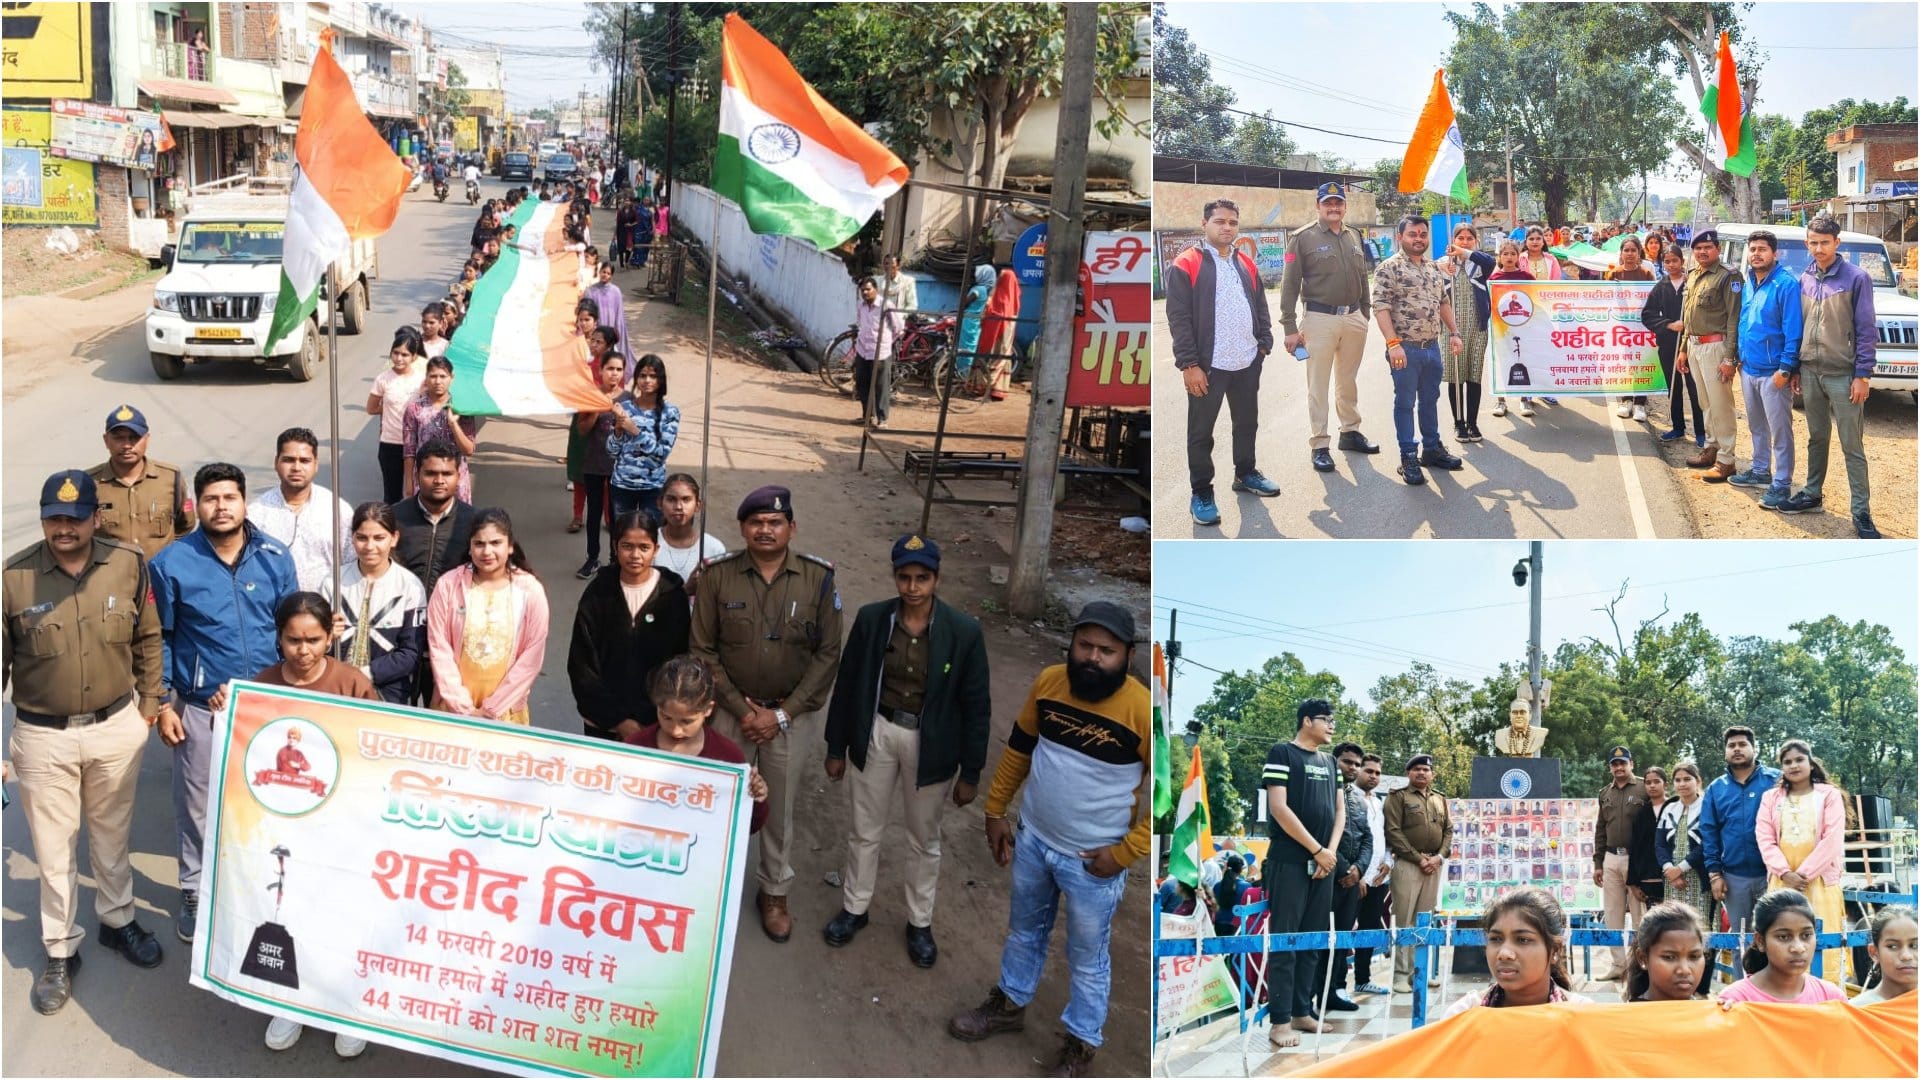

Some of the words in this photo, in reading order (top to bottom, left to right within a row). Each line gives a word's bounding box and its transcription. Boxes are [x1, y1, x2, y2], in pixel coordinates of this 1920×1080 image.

[1091, 237, 1151, 274] ही
[1616, 289, 1631, 299] की
[1551, 326, 1606, 348] शहीद
[360, 731, 471, 766] पुलवामा
[479, 751, 565, 783] शहीदों
[573, 766, 615, 790] की
[622, 775, 681, 802] याद
[688, 782, 718, 809] में
[551, 807, 695, 872] यात्रा
[372, 848, 528, 923] शहीद
[540, 866, 695, 953] दिवस
[257, 953, 285, 970] जवान
[259, 941, 283, 958] अमर
[405, 922, 427, 945] 14
[436, 928, 496, 960] फरवरी
[500, 943, 553, 970] 2019
[562, 951, 594, 979] वर्ष
[600, 954, 618, 984] में
[357, 949, 433, 983] पुलवामा
[439, 965, 487, 994] हमले
[491, 970, 509, 998] में
[513, 979, 570, 1012] शहीद
[575, 993, 604, 1024] हुए
[609, 1001, 660, 1032] हमारे
[362, 987, 390, 1010] 44
[398, 995, 462, 1026] जवानों
[468, 1004, 498, 1034] को
[502, 1017, 539, 1042] शत
[545, 1026, 582, 1052] शत
[587, 1035, 644, 1069] नमन्!
